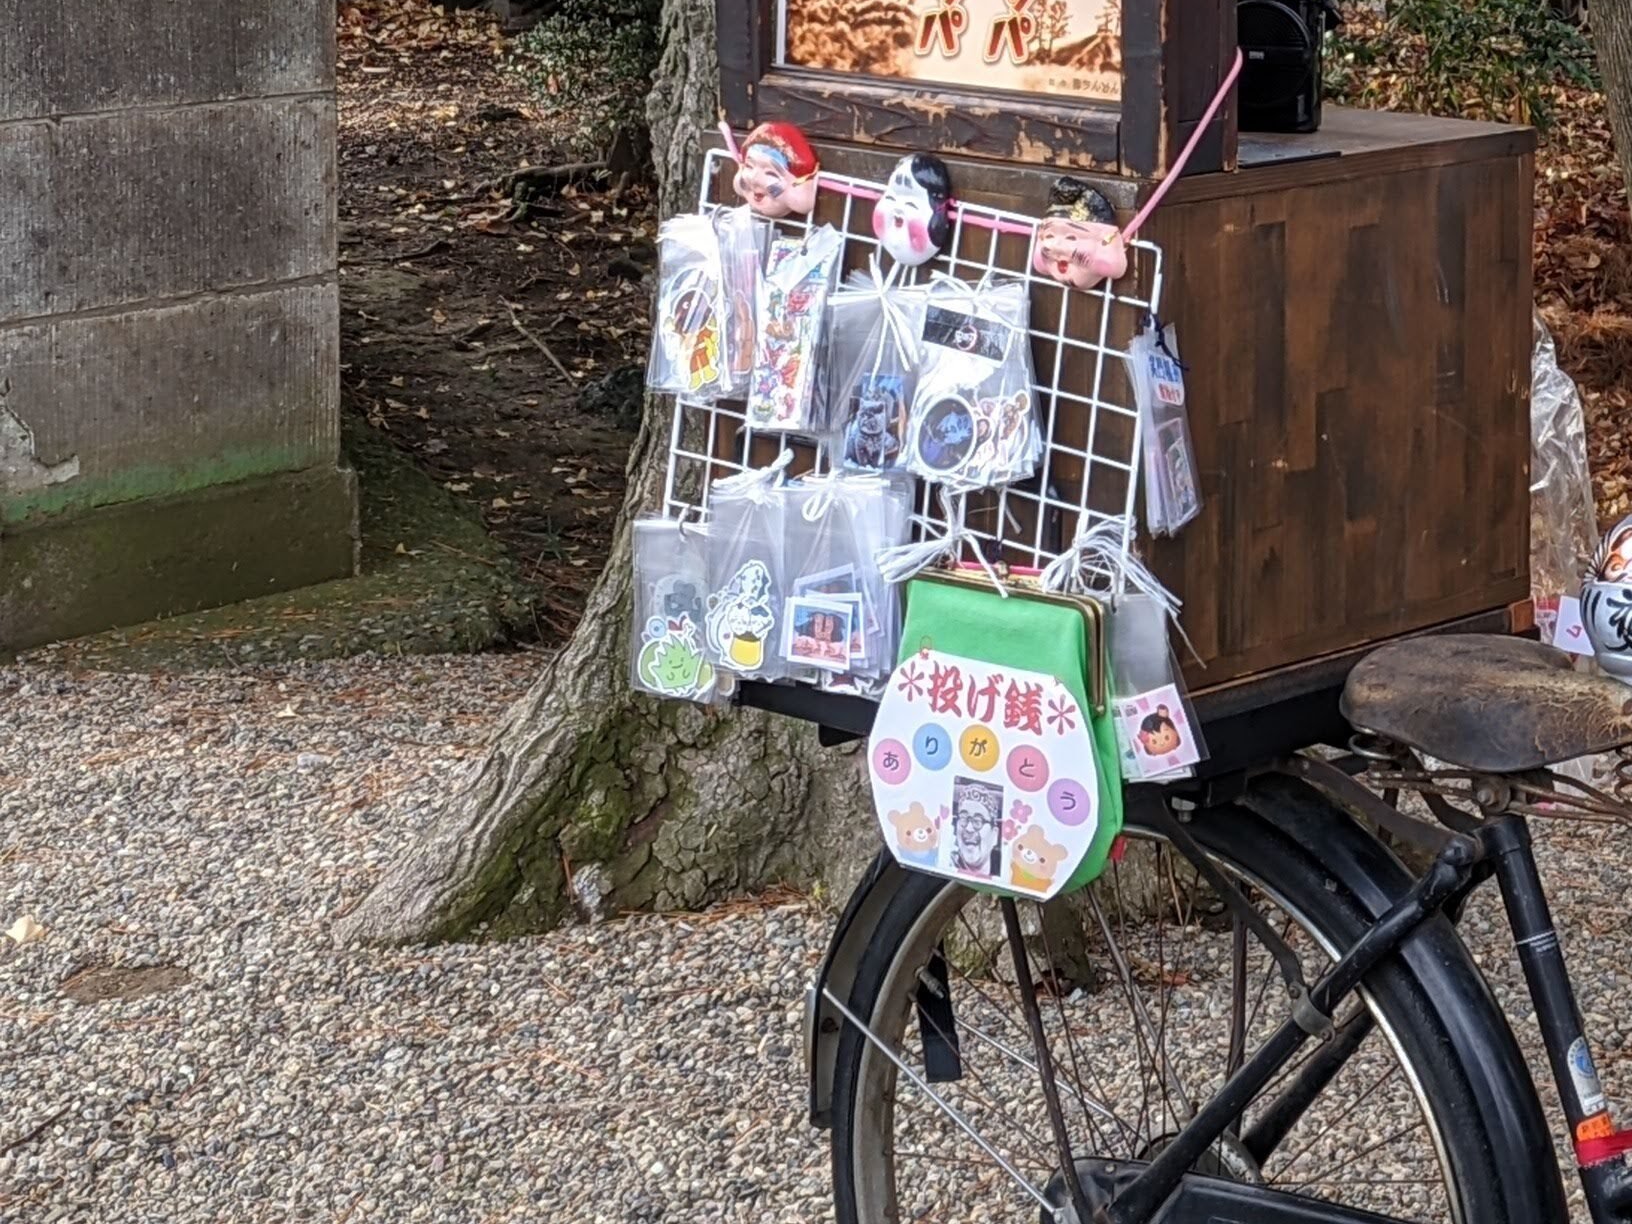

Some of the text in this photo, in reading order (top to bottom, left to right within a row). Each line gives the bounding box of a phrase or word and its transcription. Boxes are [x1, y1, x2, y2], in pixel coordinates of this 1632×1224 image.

[927, 661, 1043, 736] 投げ銭
[883, 736, 1076, 810] ありがとう
